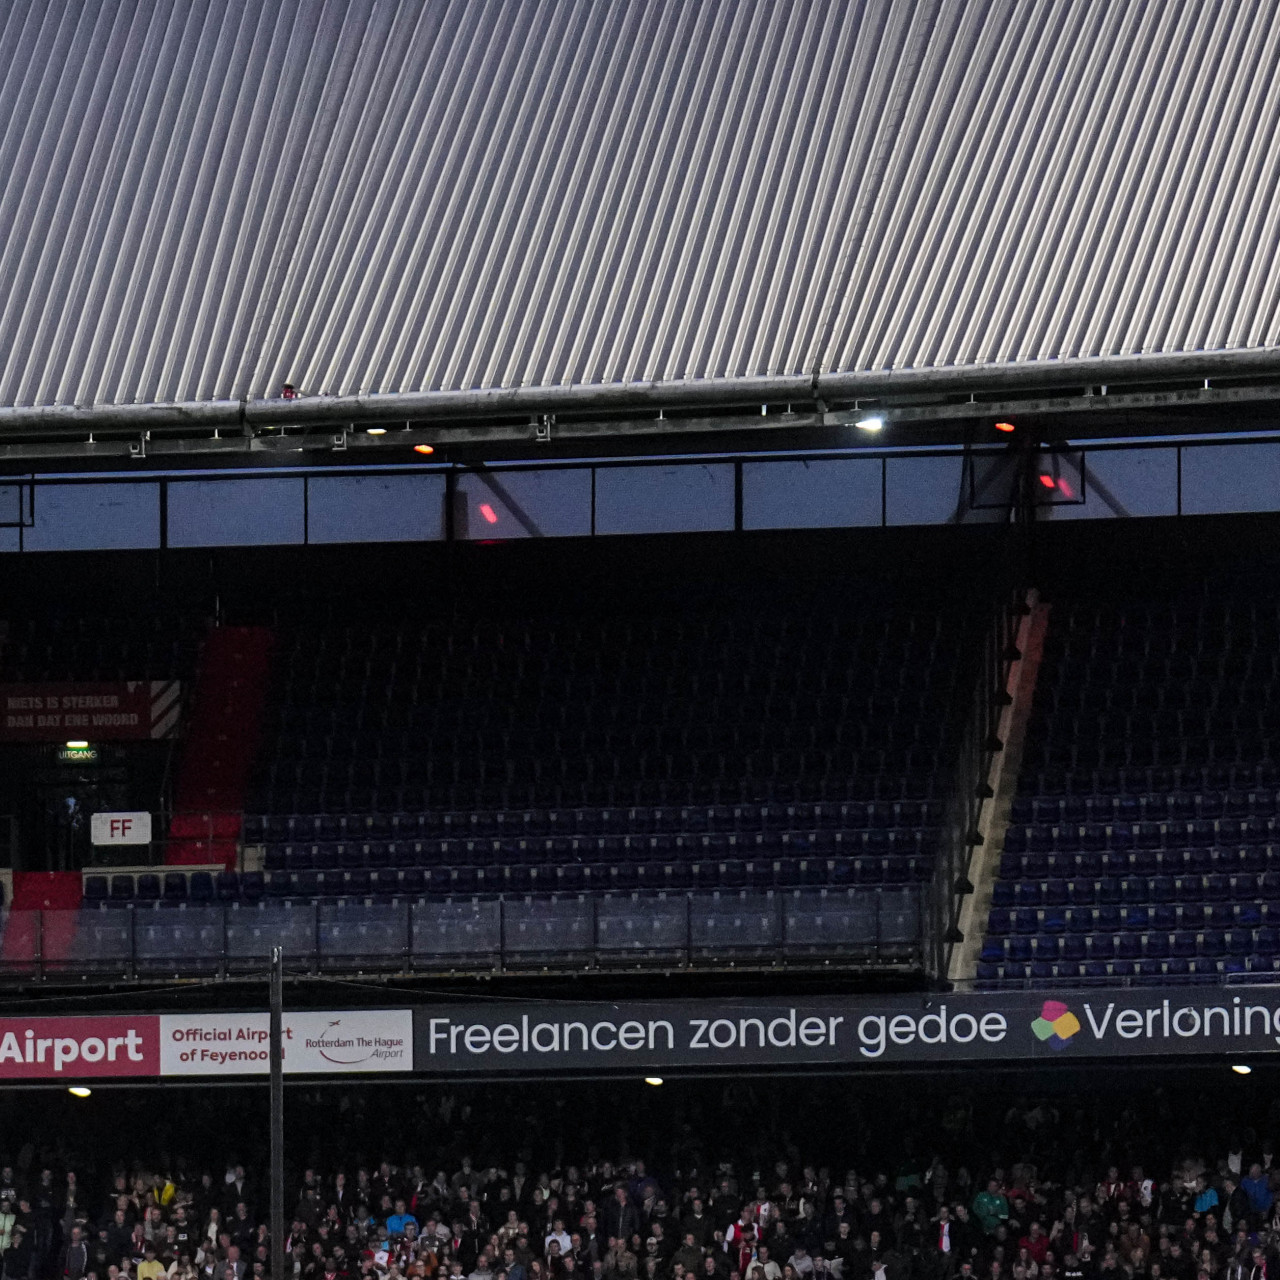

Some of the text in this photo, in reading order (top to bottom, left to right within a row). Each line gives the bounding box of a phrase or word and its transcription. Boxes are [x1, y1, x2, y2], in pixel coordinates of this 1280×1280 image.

[46, 696, 59, 709] IS
[57, 750, 98, 760] UITGANG
[109, 819, 133, 837] FF
[172, 1026, 293, 1044] Official Airpt
[428, 1005, 1008, 1059] Freelancen zonder gedoe
[305, 1036, 404, 1049] Rotterdam The Hague
[179, 1047, 286, 1065] of Feyenoo
[370, 1048, 404, 1060] Airport
